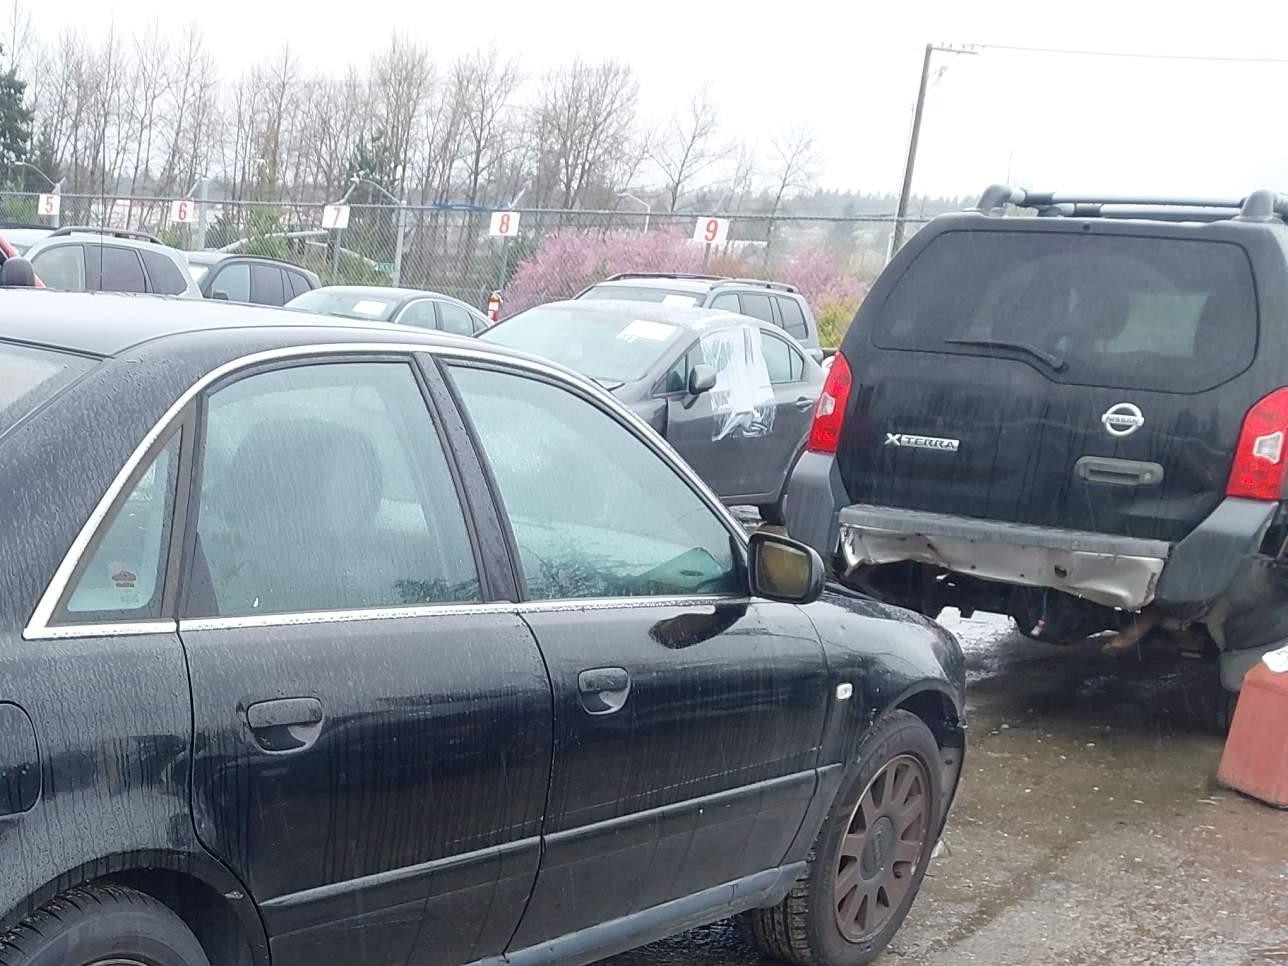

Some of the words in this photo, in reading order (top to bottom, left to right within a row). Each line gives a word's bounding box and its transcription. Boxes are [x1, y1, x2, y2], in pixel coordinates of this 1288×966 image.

[45, 195, 54, 213] 5
[178, 202, 188, 221] 6
[332, 206, 342, 226] 7
[499, 213, 510, 234] 8
[704, 219, 719, 242] 9
